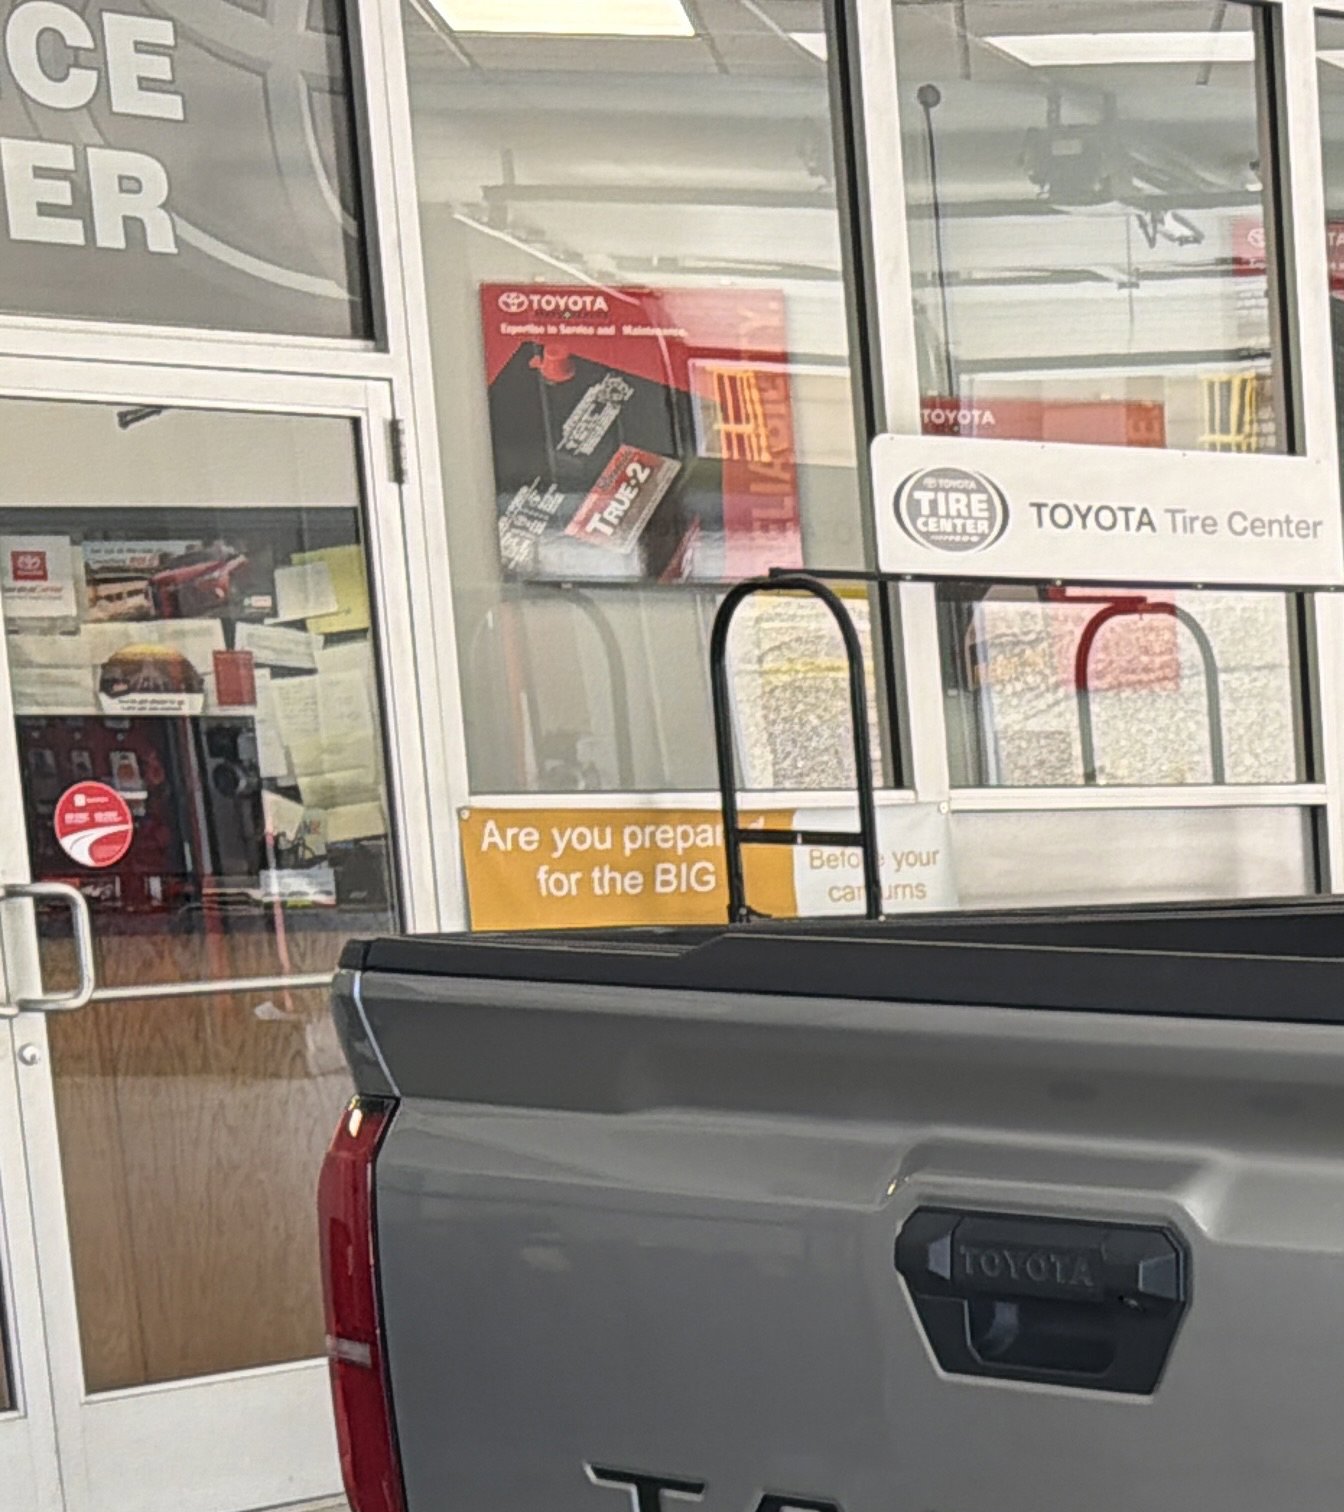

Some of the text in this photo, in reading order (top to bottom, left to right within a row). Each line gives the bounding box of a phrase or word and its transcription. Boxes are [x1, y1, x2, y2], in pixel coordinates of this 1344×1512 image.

[529, 294, 609, 312] TOYOTA
[922, 408, 995, 425] TOYOTA
[913, 490, 990, 518] TIRE
[916, 516, 990, 534] CENTER
[1029, 502, 1324, 539] TOYOTA Tire Center
[481, 819, 540, 851] Are
[551, 825, 613, 859] you
[808, 849, 940, 872] Befo your
[536, 861, 716, 897] for the BIG
[959, 1244, 1095, 1286] TOYOTA
